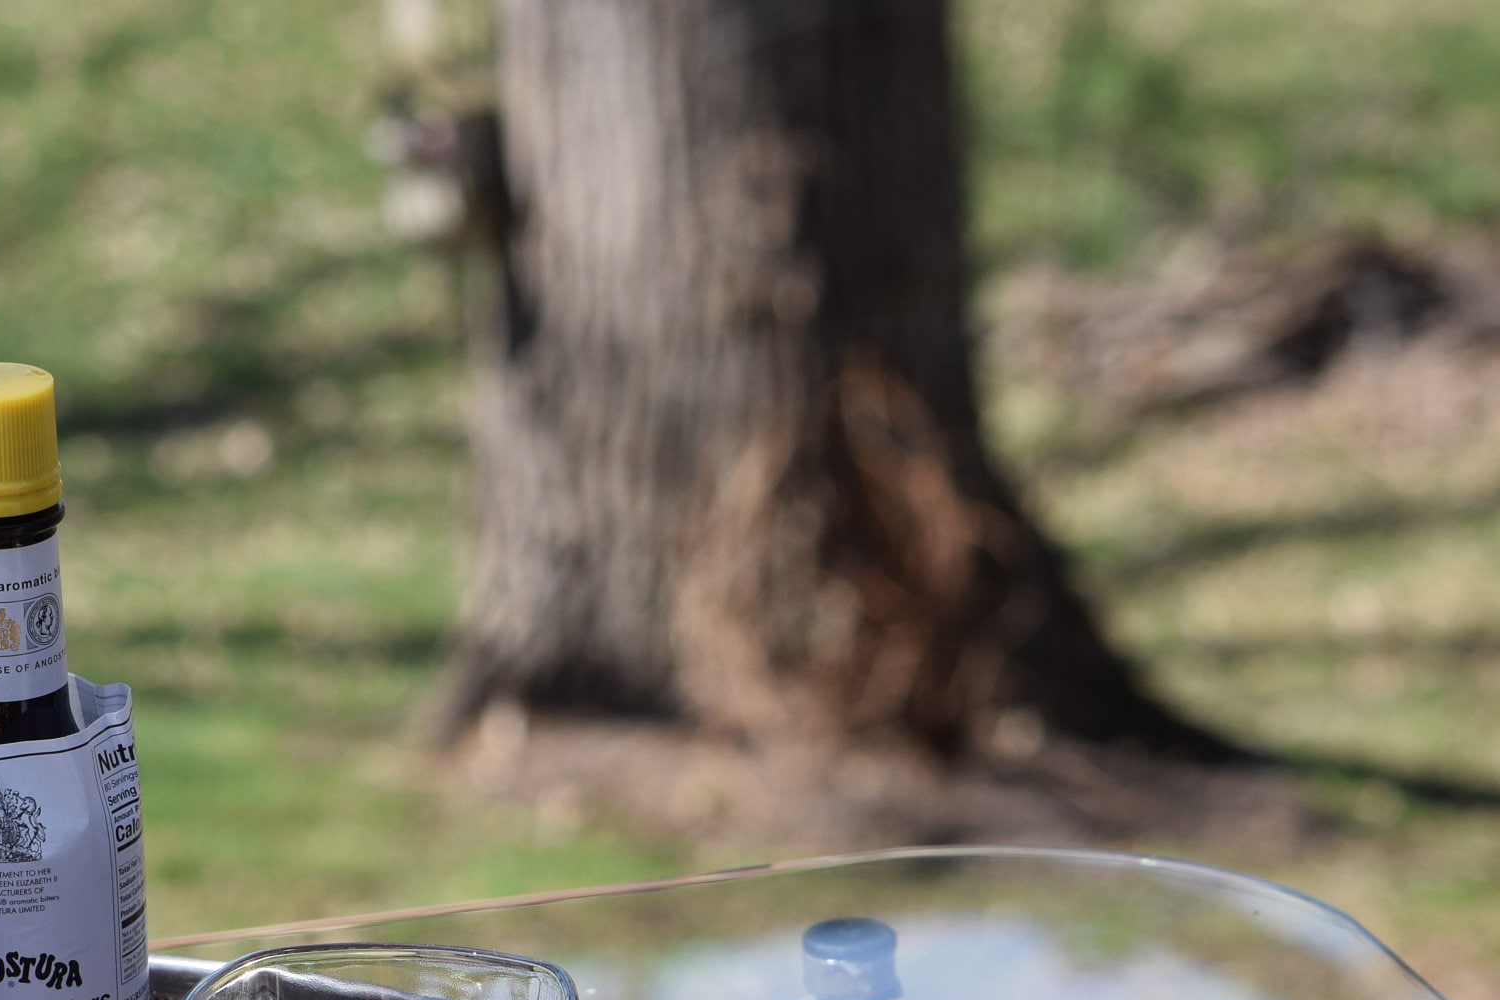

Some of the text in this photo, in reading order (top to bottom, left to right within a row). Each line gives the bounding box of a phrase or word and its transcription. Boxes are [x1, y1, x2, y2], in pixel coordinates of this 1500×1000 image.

[15, 664, 30, 673] OF
[34, 650, 65, 670] ANGOST
[104, 770, 139, 793] 80 Servings
[107, 785, 138, 807] Serving
[114, 808, 134, 825] Amount
[25, 869, 36, 877] TO
[37, 868, 52, 876] HER
[16, 877, 52, 887] ELIZABETH
[40, 895, 60, 903] bitters
[18, 905, 46, 914] LIMITED
